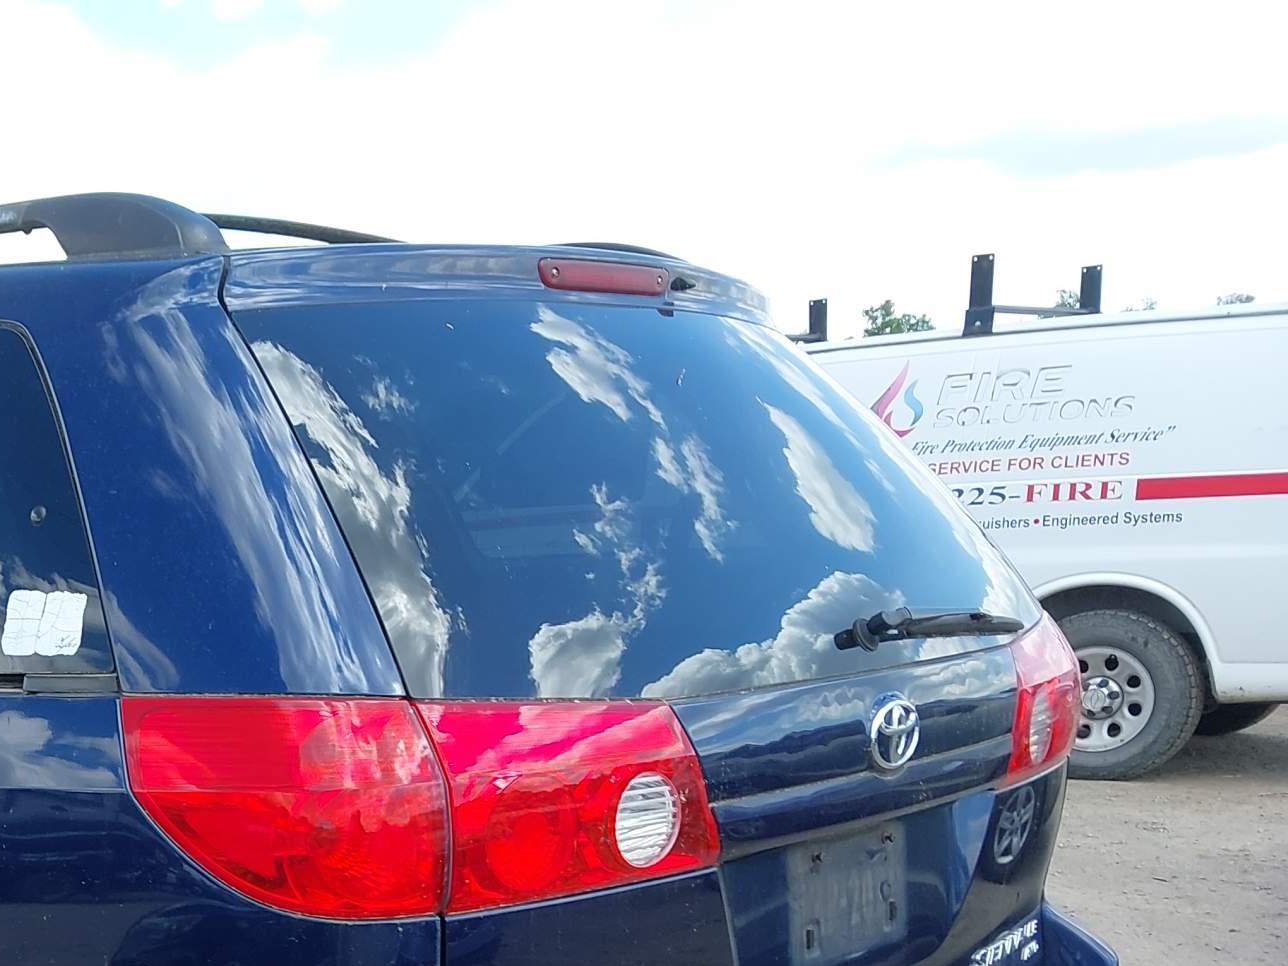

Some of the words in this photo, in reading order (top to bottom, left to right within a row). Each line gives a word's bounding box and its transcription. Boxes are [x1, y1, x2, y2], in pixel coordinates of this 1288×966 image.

[937, 365, 1073, 406] FIRE
[933, 395, 1136, 429] SOLUTIONS
[941, 436, 1016, 454] Protection
[1018, 430, 1105, 452] Equipment
[1007, 456, 1045, 472] FOR
[1051, 451, 1131, 469] CLIENTS
[978, 517, 1030, 530] uishers
[1042, 512, 1119, 529] Engineered
[1123, 511, 1183, 527] Systems
